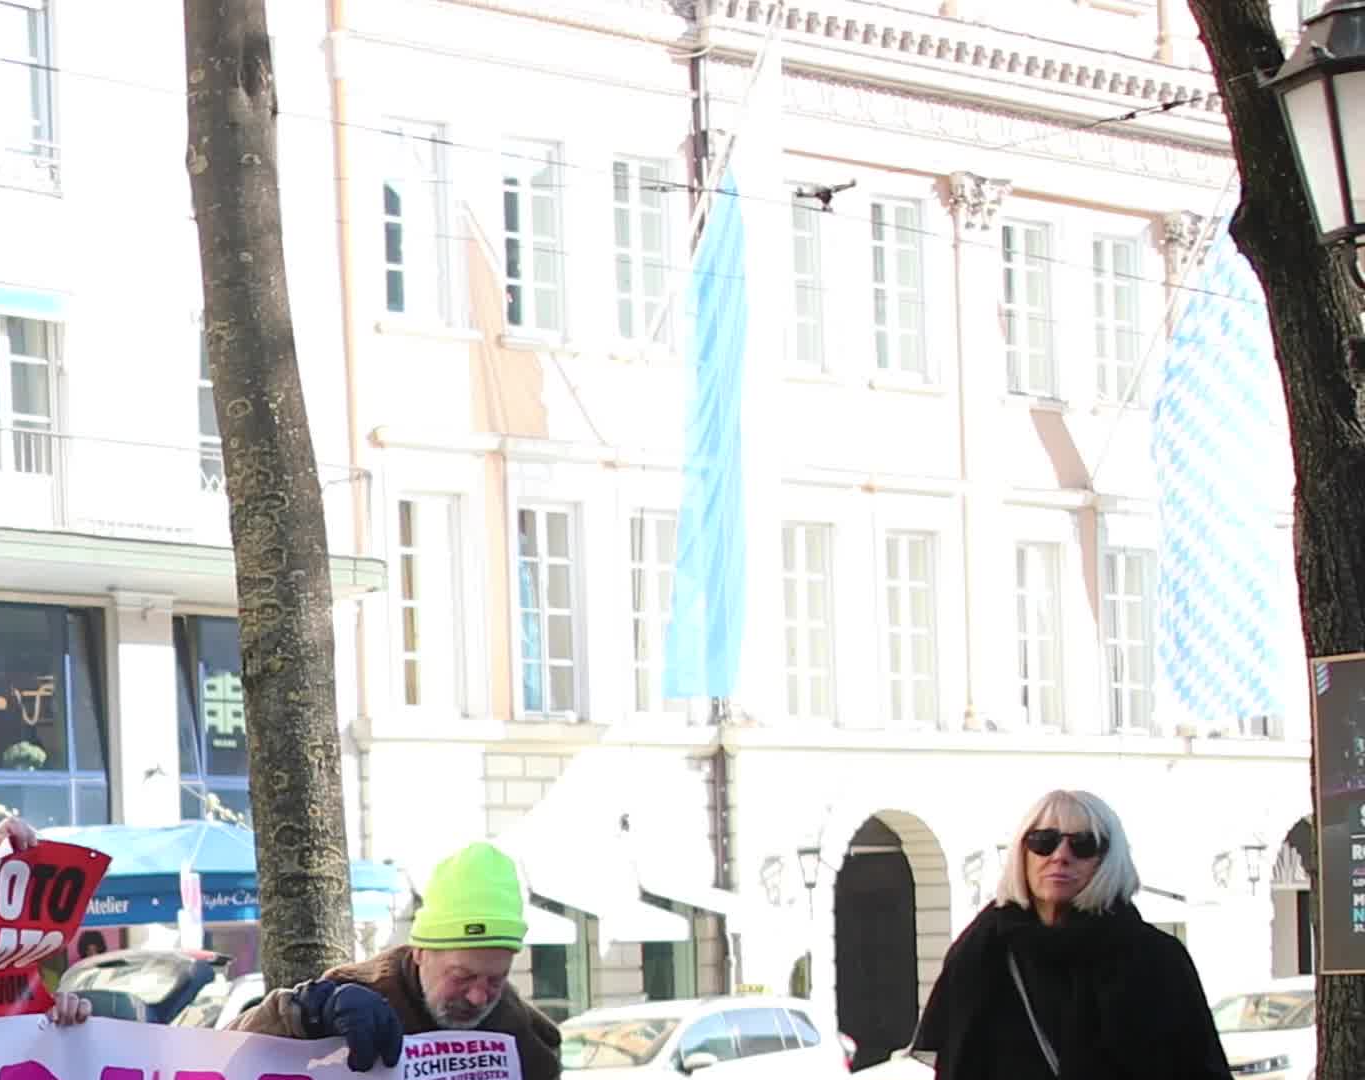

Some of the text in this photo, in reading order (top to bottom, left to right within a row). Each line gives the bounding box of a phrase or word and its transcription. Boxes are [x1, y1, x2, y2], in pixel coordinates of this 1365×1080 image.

[32, 863, 86, 923] TO
[86, 895, 130, 914] Atelier
[405, 1040, 506, 1059] HANDELN
[414, 1055, 508, 1078] SCHIESSEN!
